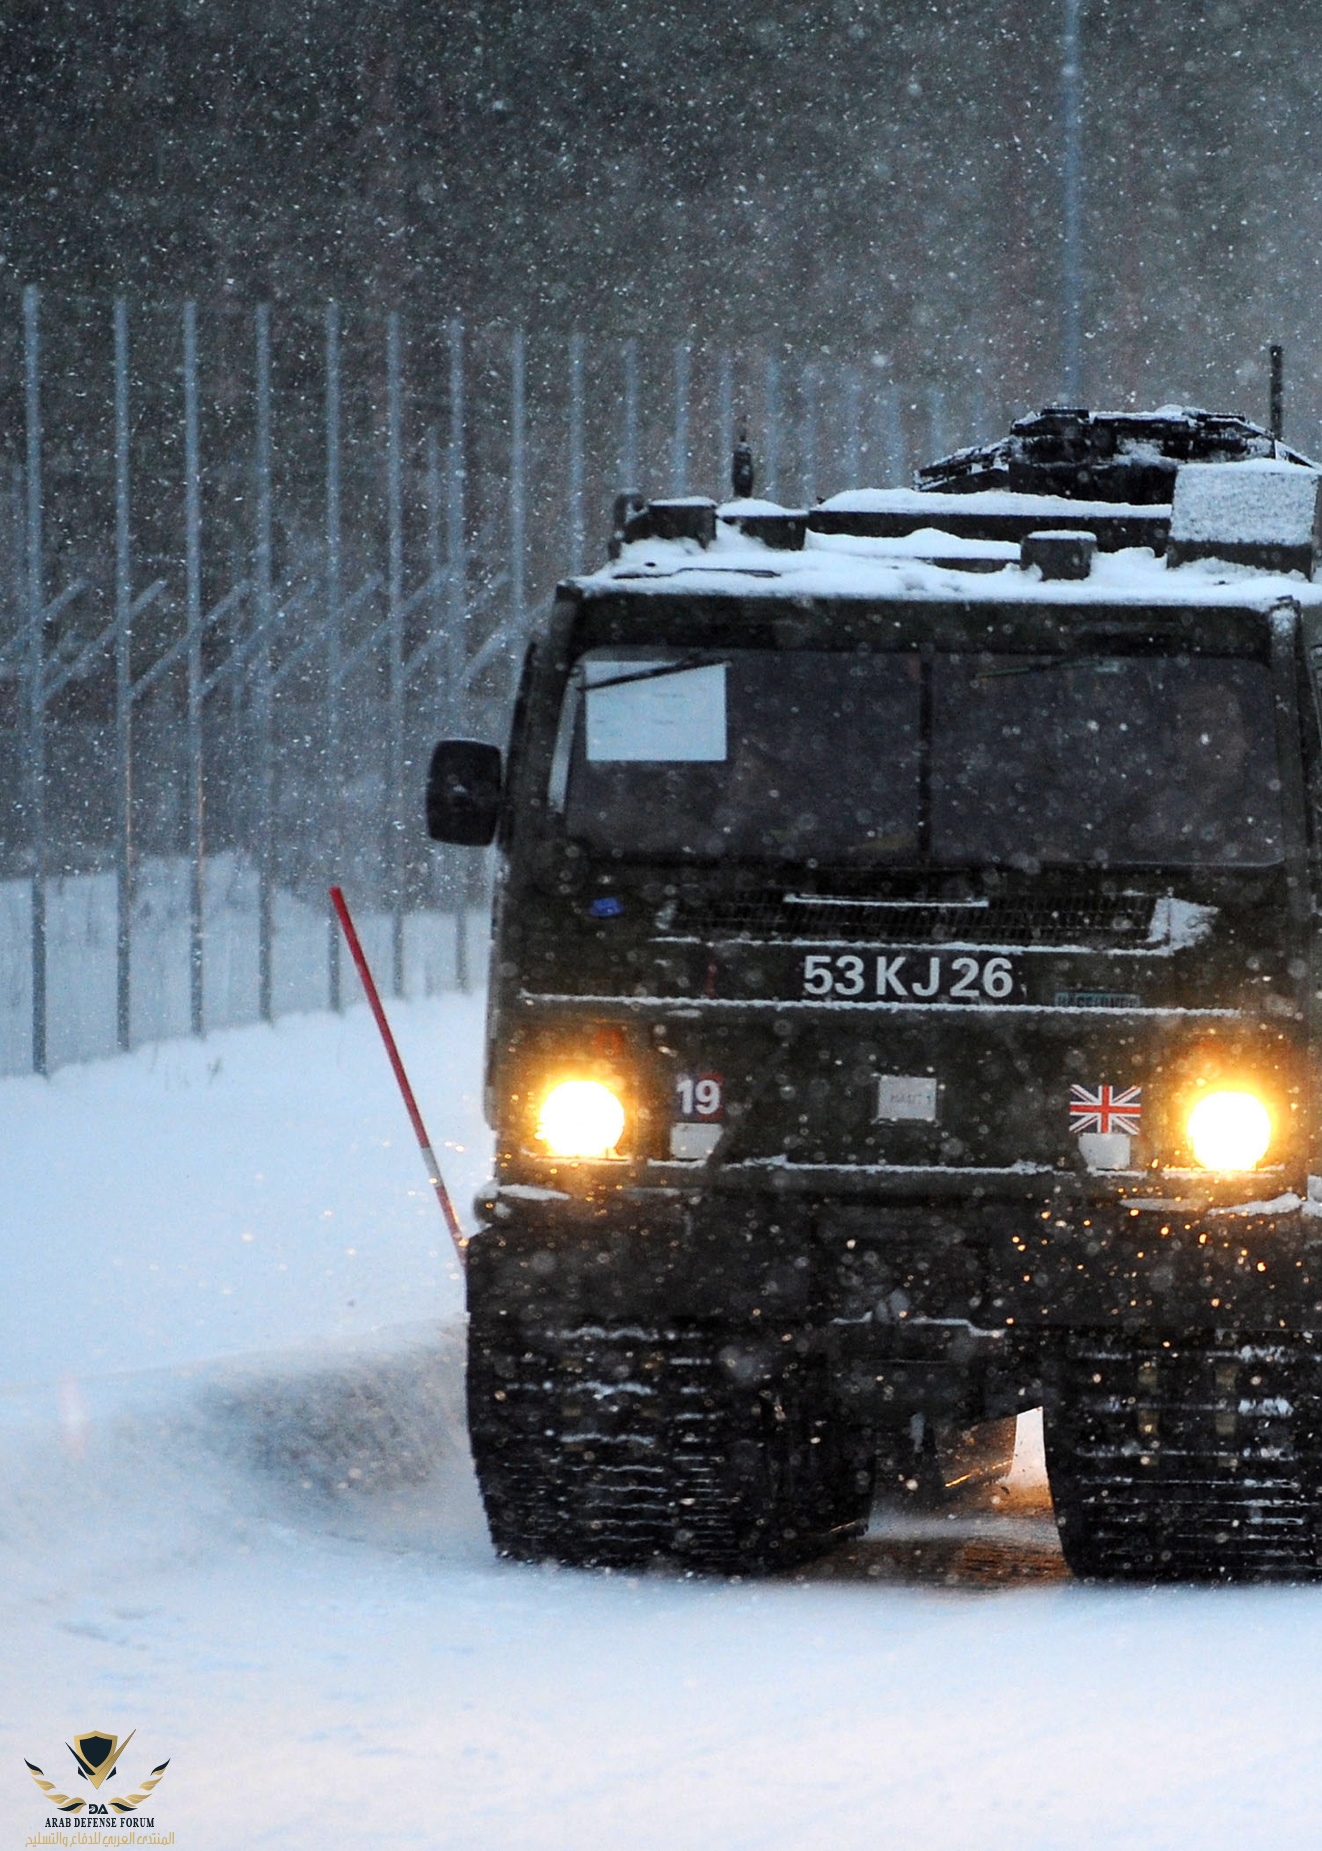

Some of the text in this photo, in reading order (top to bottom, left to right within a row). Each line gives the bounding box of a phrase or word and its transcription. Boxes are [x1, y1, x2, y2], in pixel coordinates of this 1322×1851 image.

[804, 955, 1013, 998] 53 KJ 26
[676, 1079, 720, 1115] 19
